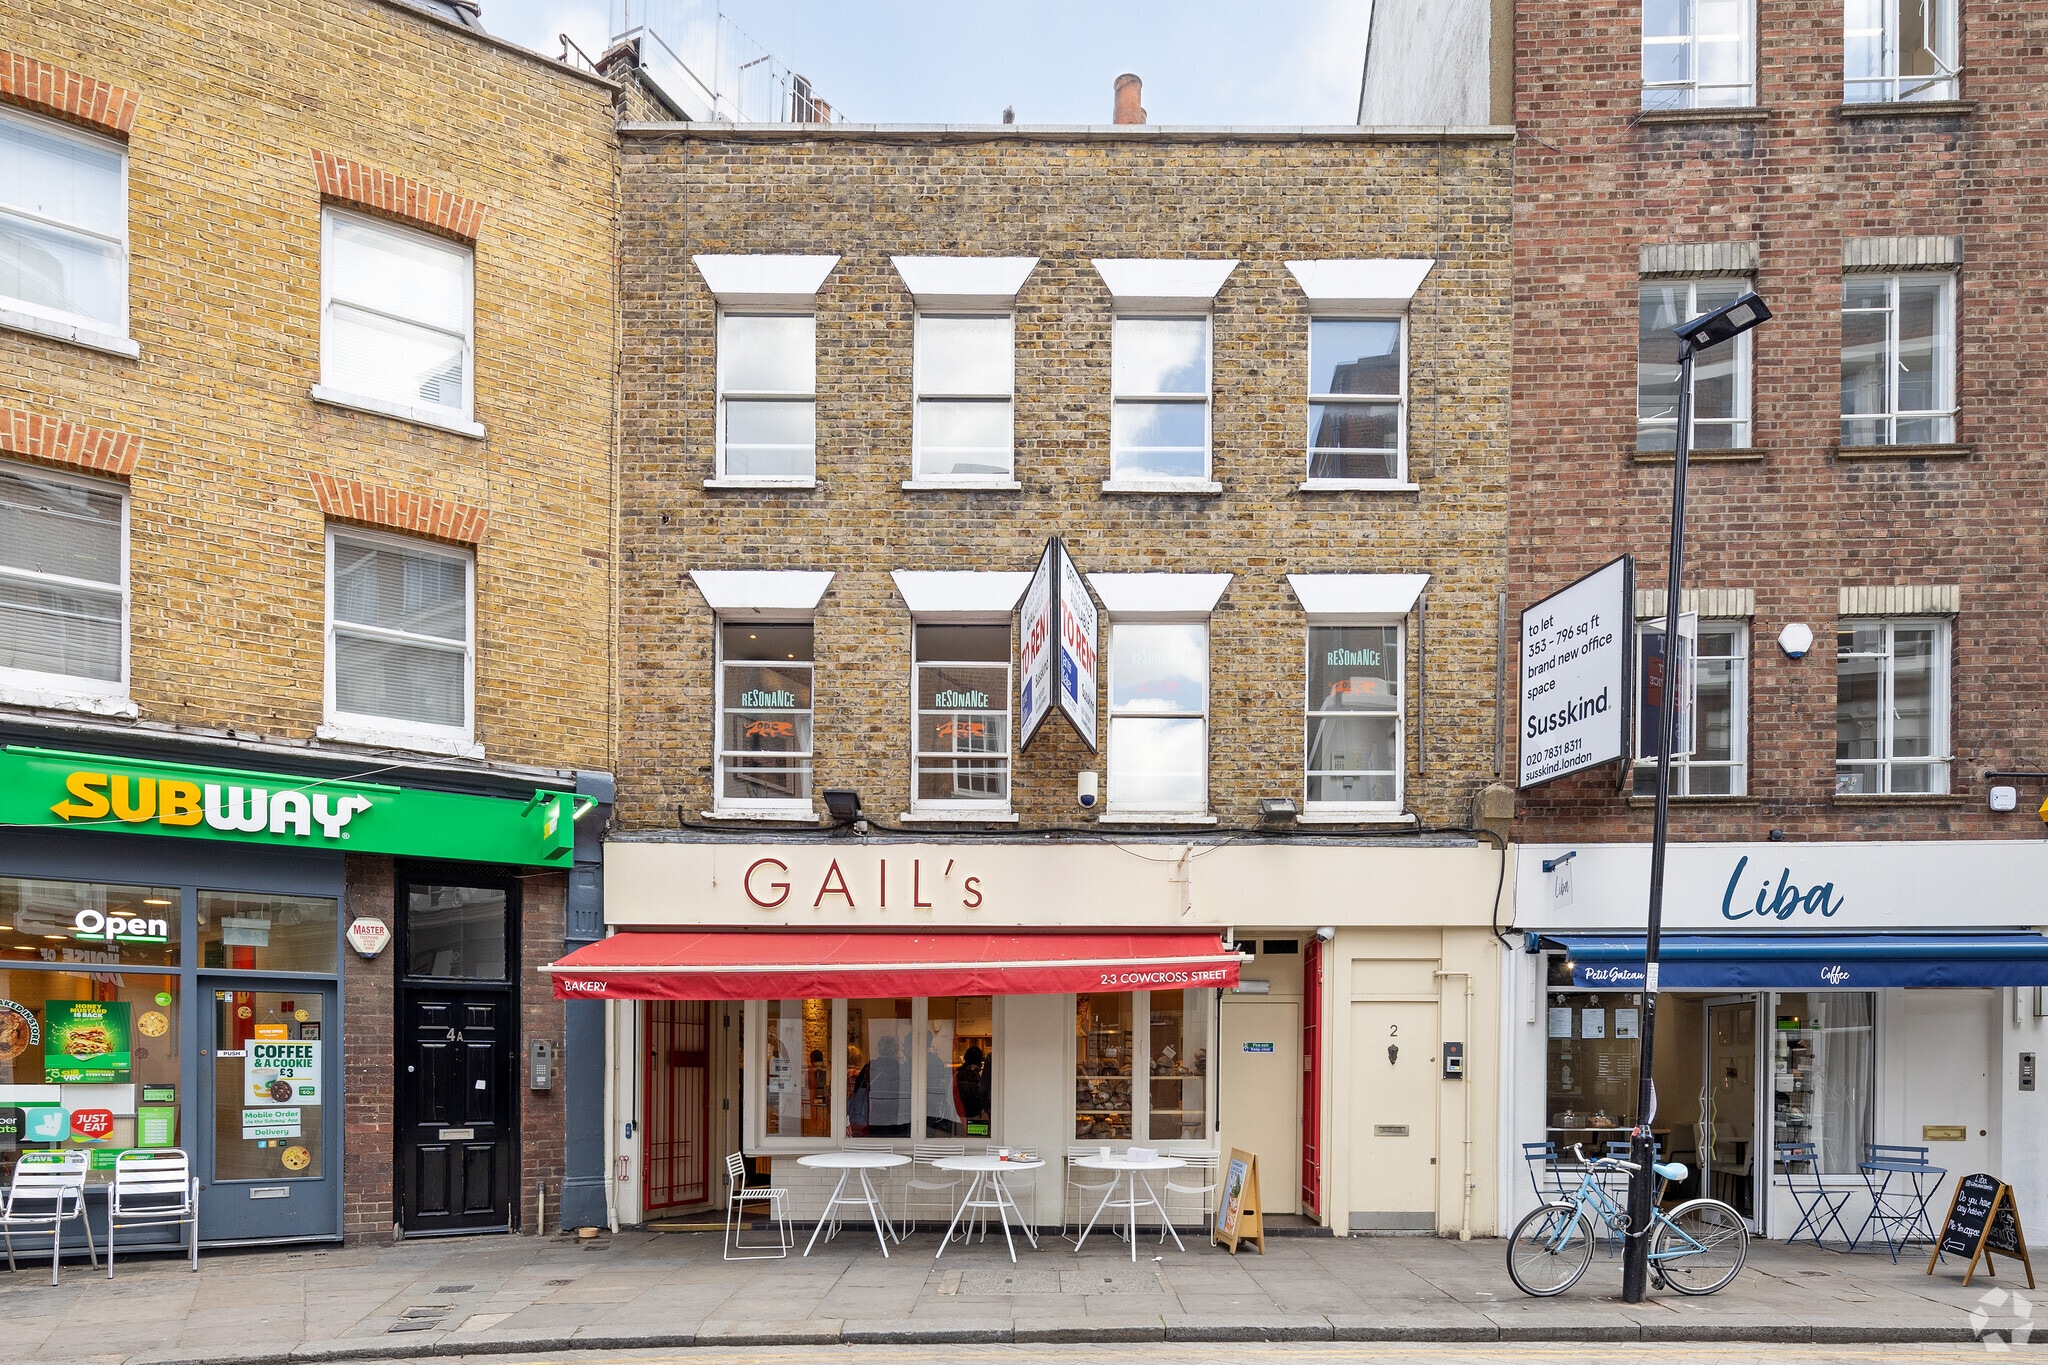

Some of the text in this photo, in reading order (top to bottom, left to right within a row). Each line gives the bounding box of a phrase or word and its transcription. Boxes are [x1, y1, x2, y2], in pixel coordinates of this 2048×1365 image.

[1528, 614, 1554, 637] to let
[1021, 641, 1031, 681] TO
[1030, 600, 1051, 660] RENT
[1061, 598, 1075, 648] TO
[1076, 633, 1097, 684] RENT
[1528, 641, 1547, 658] 353
[1556, 627, 1574, 648] 796
[1576, 621, 1589, 638] sq
[1589, 614, 1600, 630] ft
[1528, 632, 1613, 679] brand new office
[1527, 678, 1556, 701] space
[1526, 738, 1582, 767] 020 7831 8311
[1526, 751, 1592, 782] susskind.london
[50, 771, 373, 839] SUBWAY
[744, 858, 983, 909] GAIL's
[1722, 855, 1845, 921] Liba
[75, 909, 168, 940] Open
[354, 924, 384, 935] MASTER
[1101, 969, 1228, 985] 2-3 COWCROSS STREET
[1585, 967, 1609, 980] Petit
[1609, 967, 1645, 982] Gateau
[1821, 966, 1850, 984] Coffee
[564, 980, 607, 992] BAKERY
[0, 999, 24, 1012] AKED
[29, 1018, 39, 1045] STORE
[1390, 1025, 1398, 1037] 2
[254, 1045, 313, 1058] COFFEE
[254, 1058, 313, 1067] & A COOKIE
[280, 1068, 294, 1077] £3
[77, 1114, 108, 1124] JUST
[83, 1123, 108, 1132] EAT
[0, 1125, 17, 1133] ats
[1959, 1190, 1966, 1202] Do
[1967, 1196, 1978, 1207] you
[1957, 1205, 1967, 1216] any
